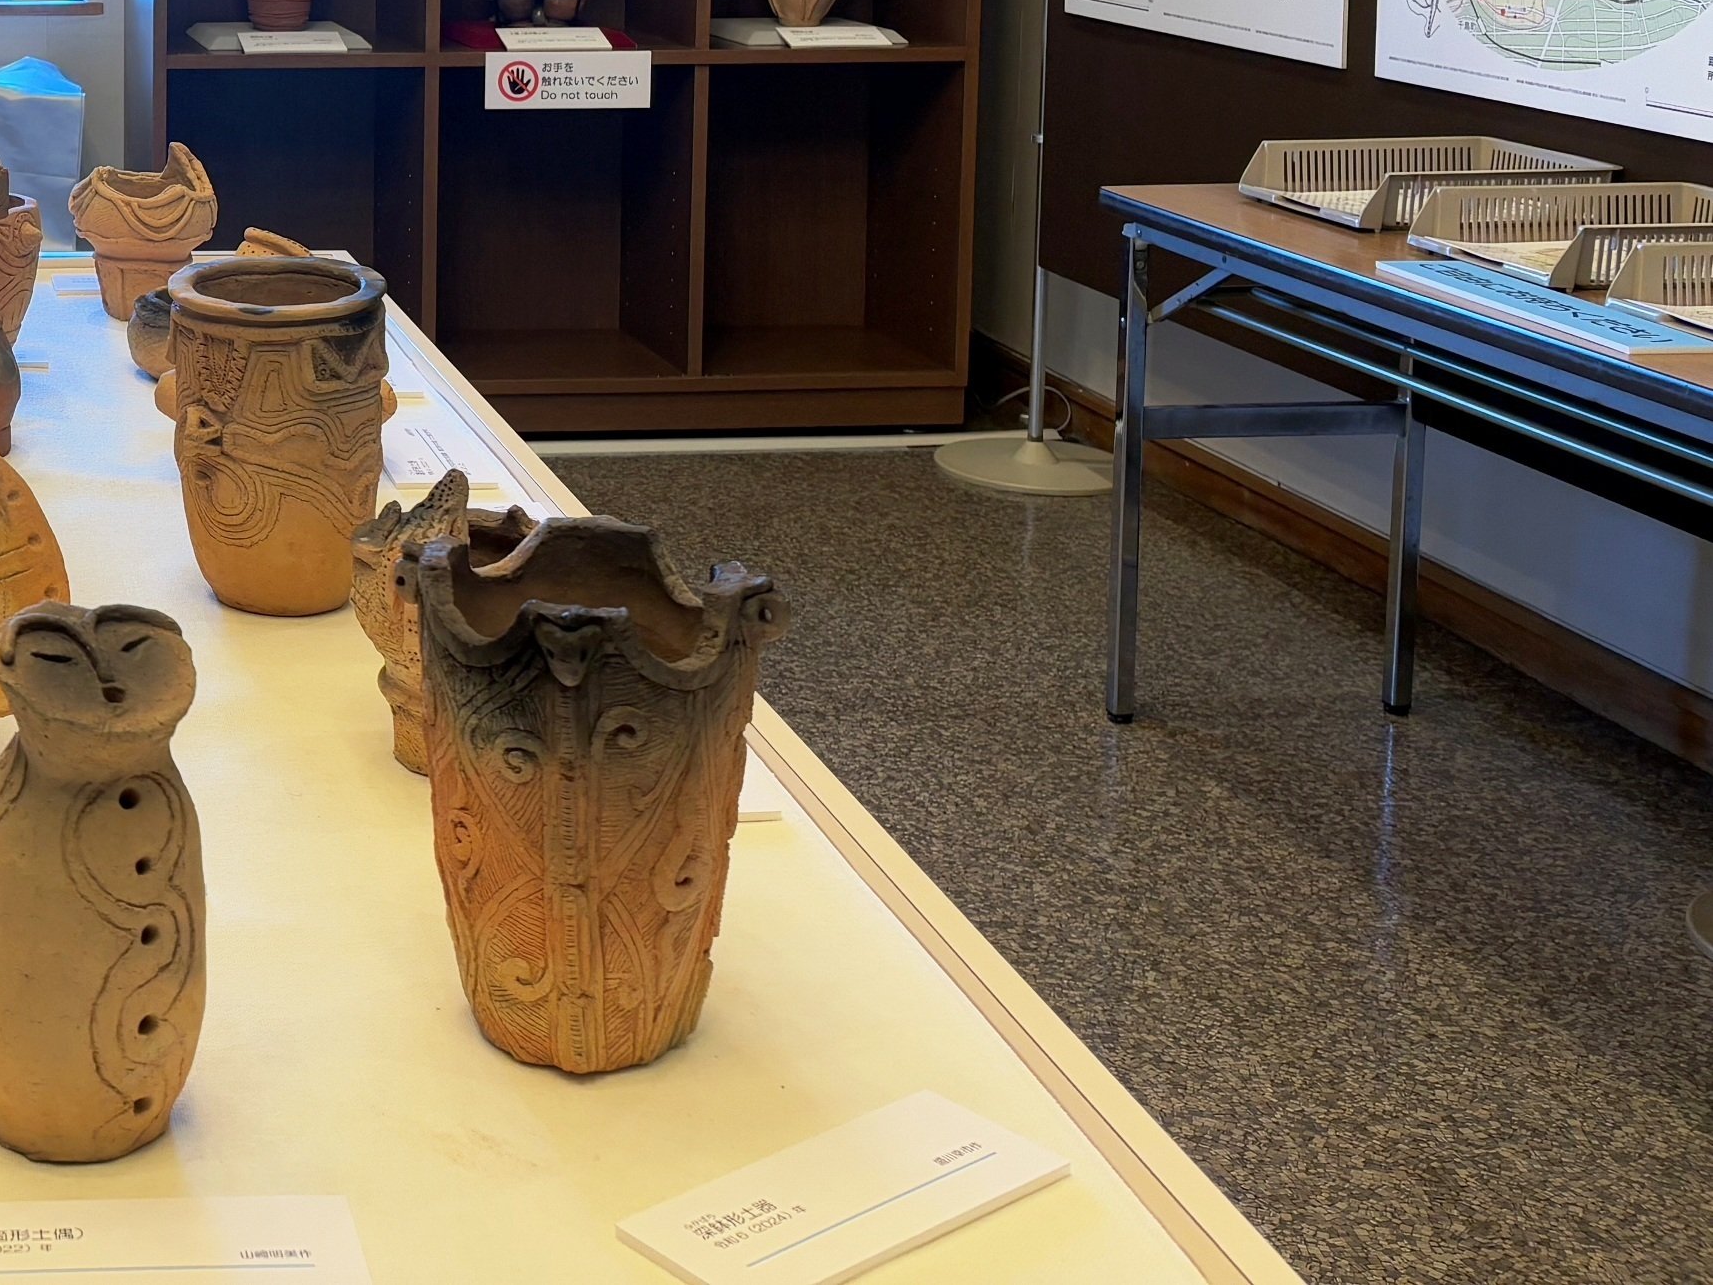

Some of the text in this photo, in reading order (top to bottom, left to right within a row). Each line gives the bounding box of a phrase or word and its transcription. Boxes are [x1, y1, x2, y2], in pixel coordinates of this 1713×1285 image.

[542, 62, 574, 73] お手を
[541, 75, 639, 86] 触れないでください
[541, 90, 618, 100] Do not touch
[692, 1198, 778, 1240] 深鉢形土器
